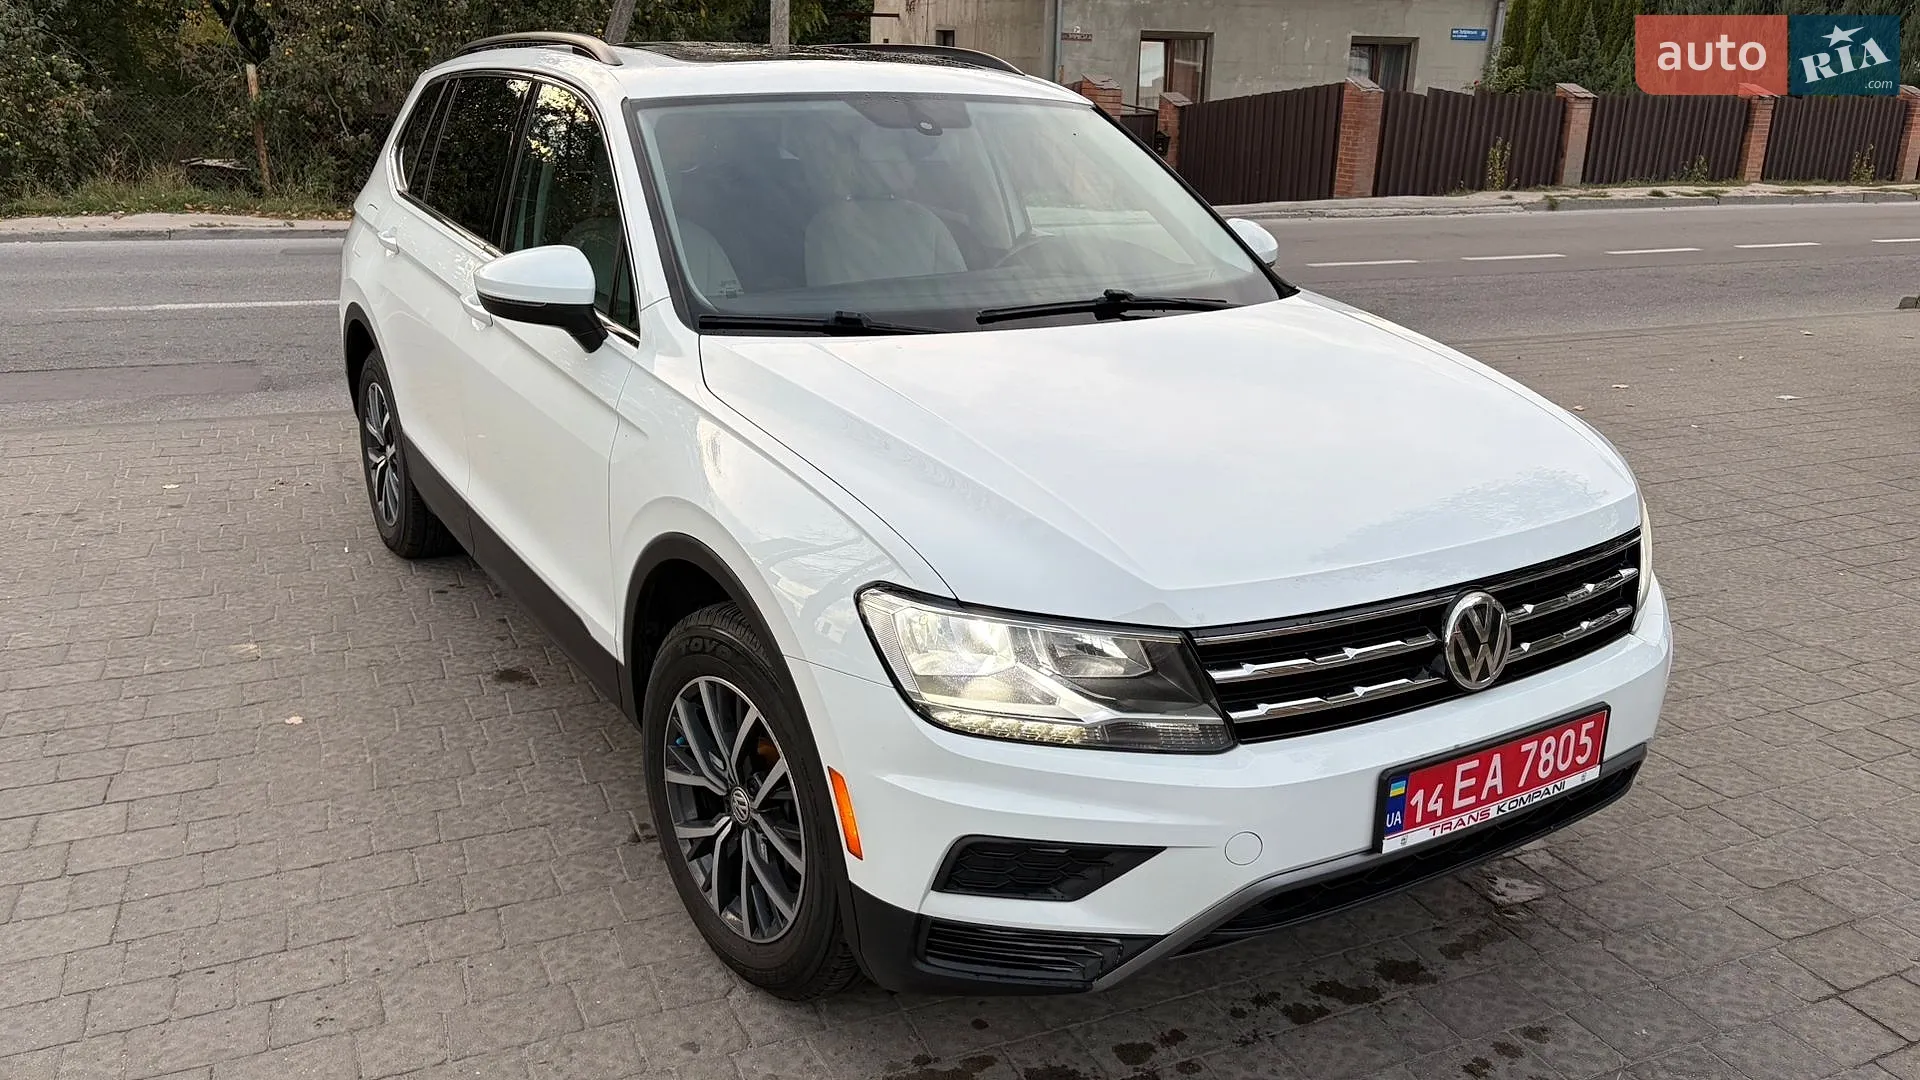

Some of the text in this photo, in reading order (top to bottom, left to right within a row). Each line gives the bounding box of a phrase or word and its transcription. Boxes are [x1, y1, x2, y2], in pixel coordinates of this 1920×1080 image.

[1518, 721, 1595, 788] 7805
[1386, 810, 1402, 828] UA
[1429, 780, 1566, 836] TRANS KOMPANI
